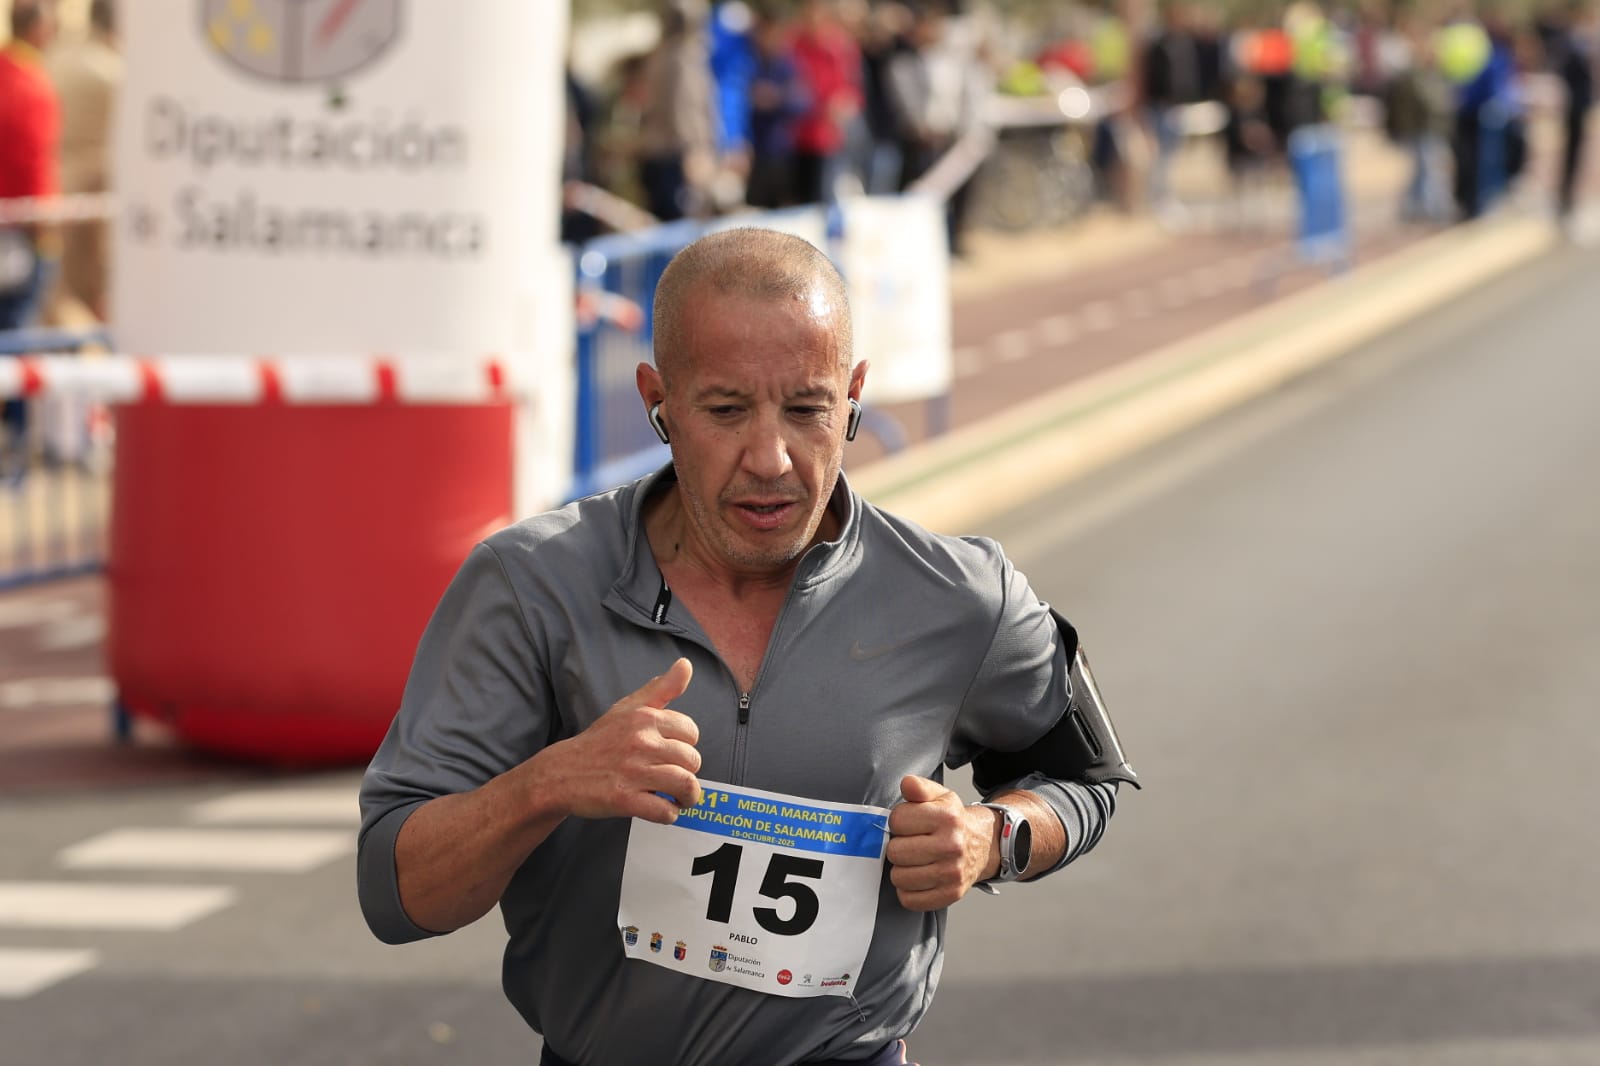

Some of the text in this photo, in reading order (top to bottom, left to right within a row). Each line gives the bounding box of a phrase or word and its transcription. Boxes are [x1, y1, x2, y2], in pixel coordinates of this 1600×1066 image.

[737, 799, 778, 816] MEDIA
[780, 807, 842, 825] MARATÓN
[679, 808, 847, 843] DIPUTACIÓN DE SALAMANCA
[691, 842, 825, 936] 15
[729, 932, 758, 945] PABLO
[728, 953, 761, 967] Diputación
[733, 966, 765, 978] Salamanca
